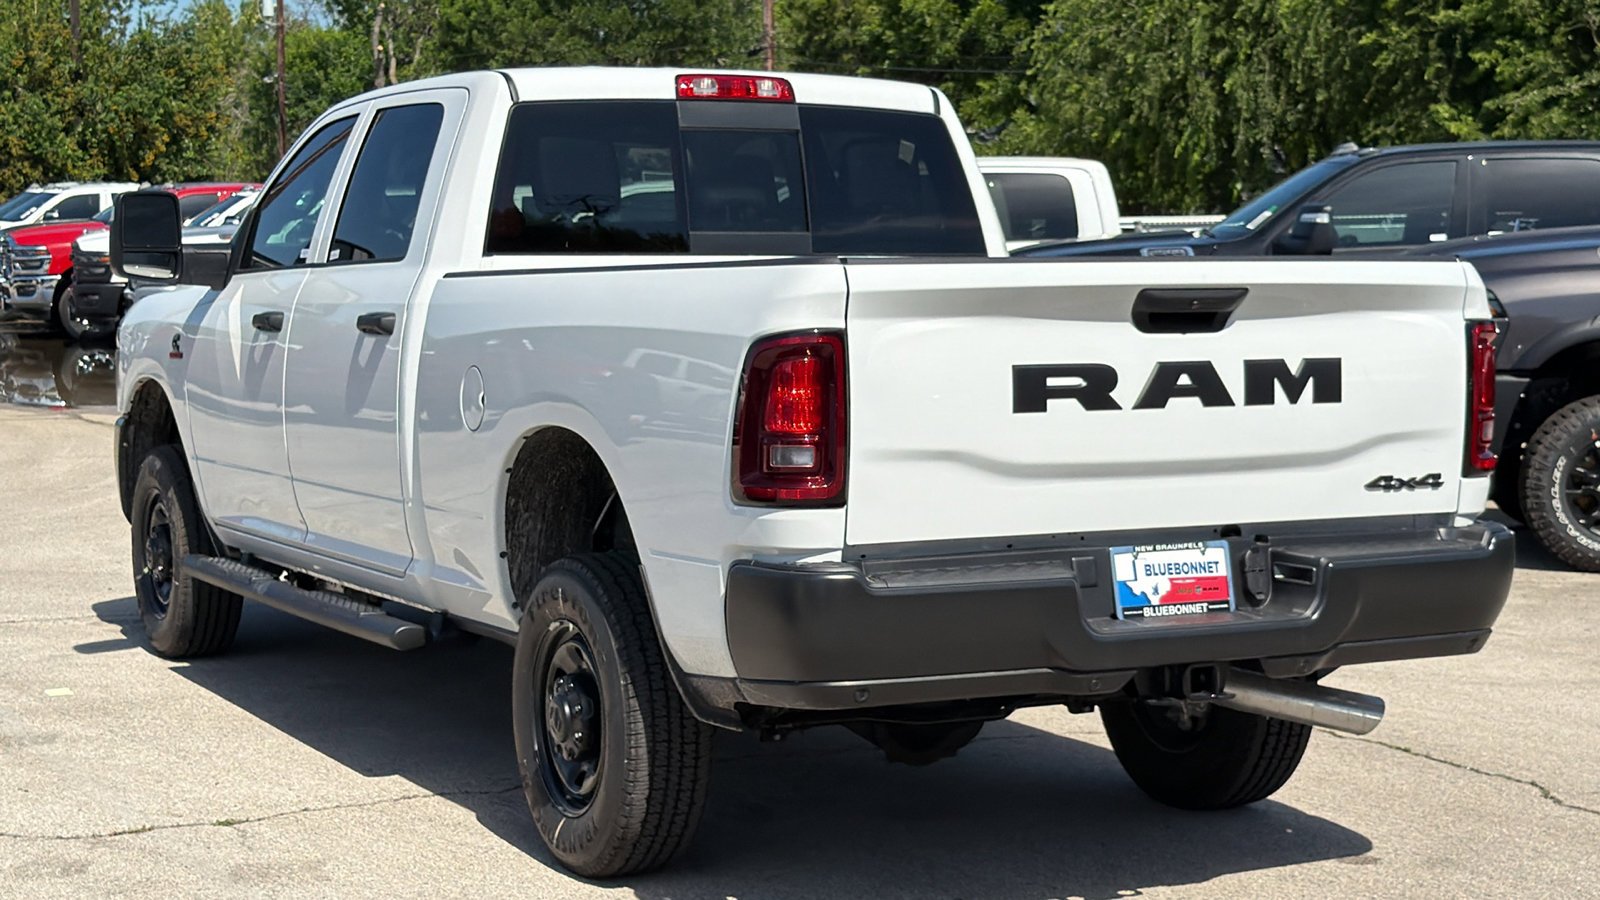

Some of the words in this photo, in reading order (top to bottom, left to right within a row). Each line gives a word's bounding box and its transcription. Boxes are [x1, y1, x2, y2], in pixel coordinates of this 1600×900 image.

[1012, 357, 1342, 414] RAM
[1363, 472, 1445, 492] 4x4
[1135, 544, 1154, 552] NEW
[1155, 541, 1204, 551] BRAUNFELS
[1144, 561, 1219, 577] BLUEBONNET
[1143, 603, 1209, 617] BLUEBONNET
